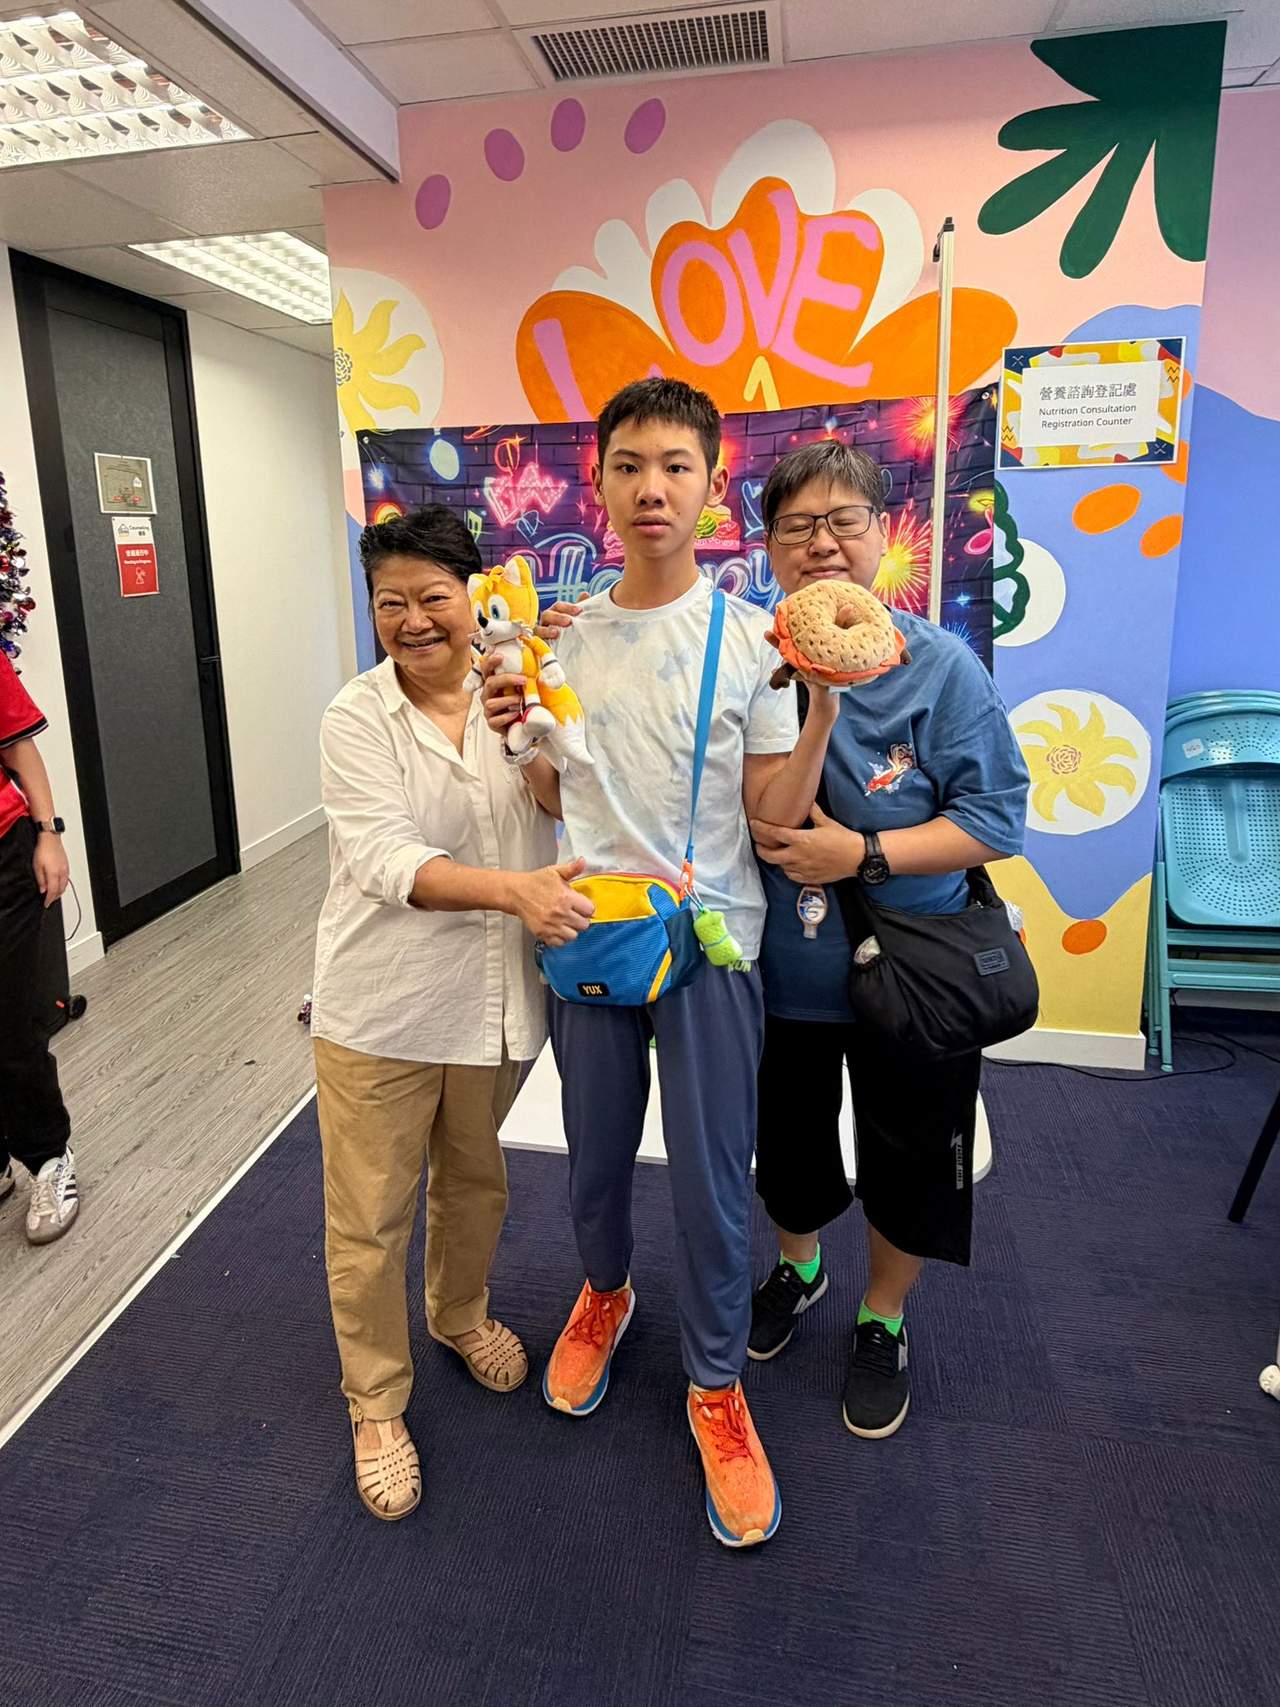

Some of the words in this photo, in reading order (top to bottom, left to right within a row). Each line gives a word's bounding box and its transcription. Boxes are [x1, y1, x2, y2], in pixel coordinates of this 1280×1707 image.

[1040, 382, 1137, 401] 營養諮詢登記處
[1039, 406, 1078, 417] Nutrition
[1080, 403, 1137, 415] Consultation
[1041, 418, 1094, 431] Registration
[1096, 417, 1133, 427] Counter
